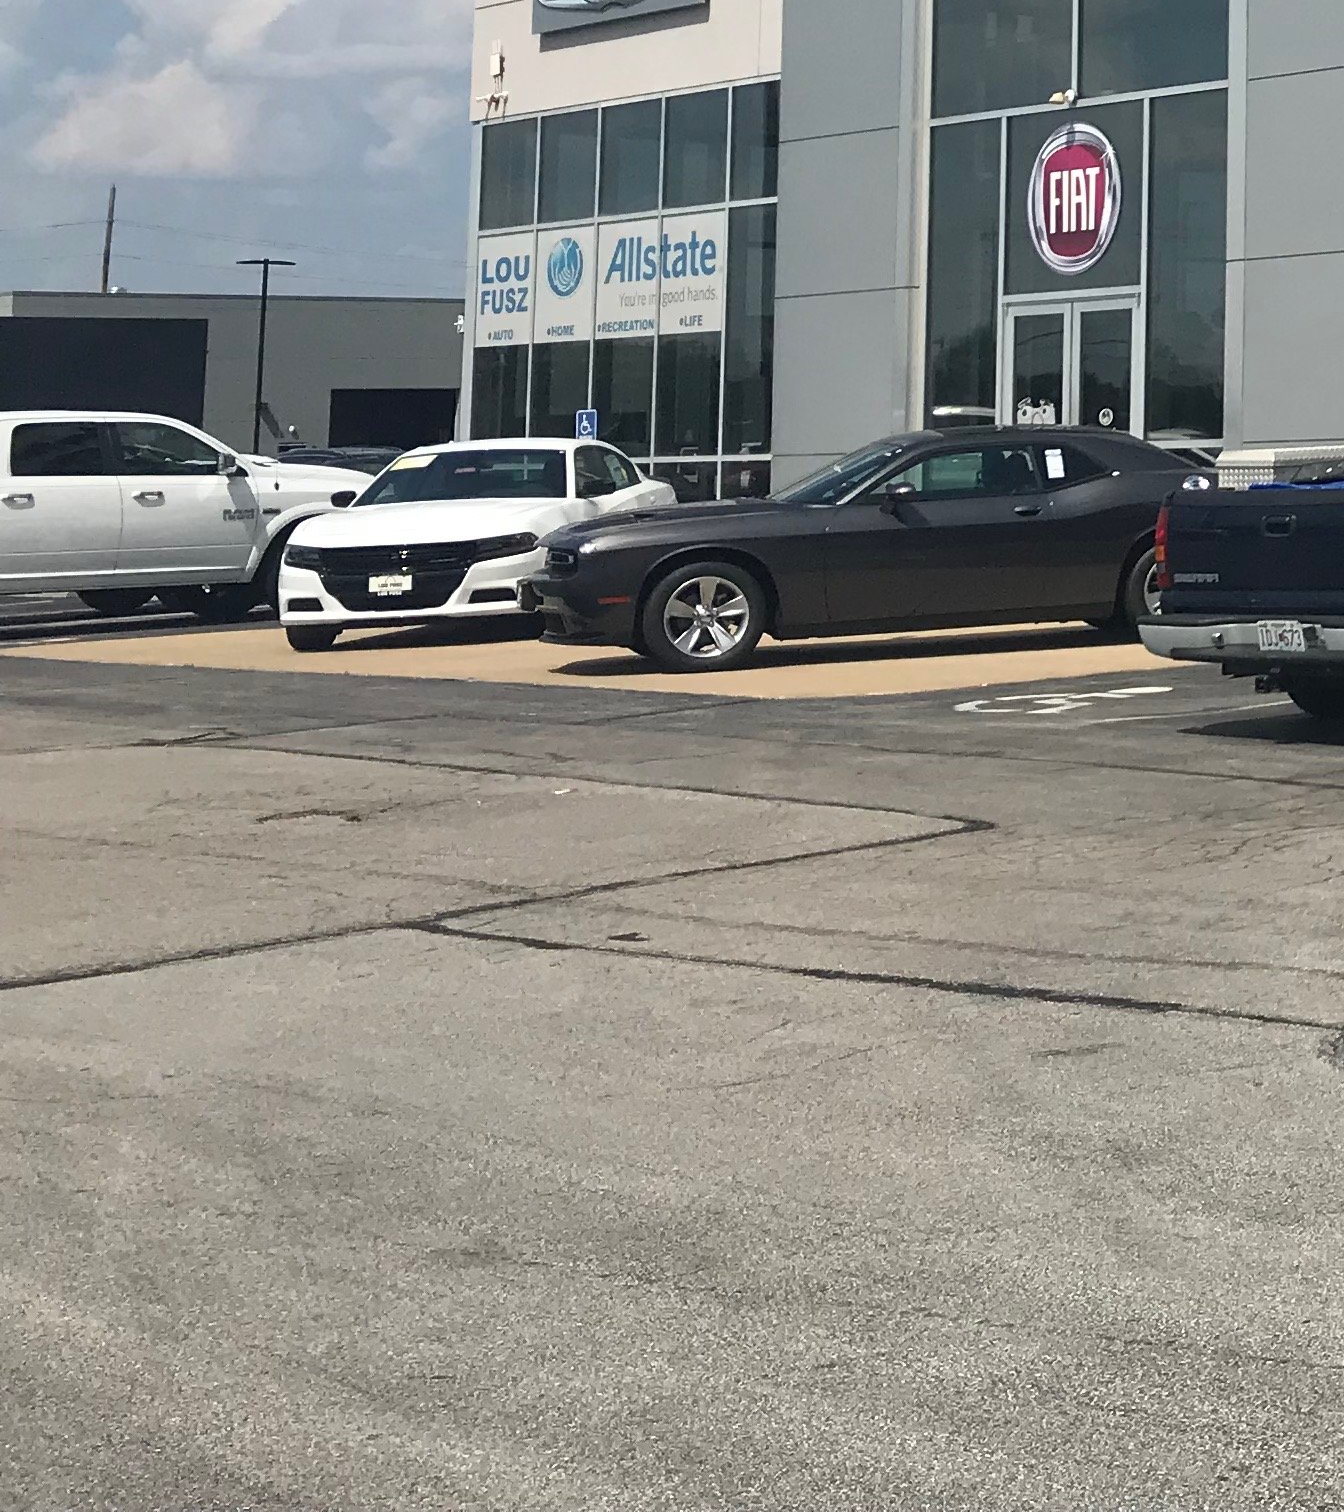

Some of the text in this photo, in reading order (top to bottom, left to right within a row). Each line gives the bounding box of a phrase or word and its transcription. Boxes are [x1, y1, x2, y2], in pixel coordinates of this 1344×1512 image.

[1049, 166, 1100, 234] FIAT
[603, 230, 717, 285] Allstate
[481, 255, 530, 284] LOU
[480, 287, 529, 316] FUSZ
[619, 291, 647, 307] You're
[662, 286, 685, 307] good
[551, 325, 575, 336] HOME
[602, 319, 655, 333] RECREATION
[684, 315, 703, 327] LIFE
[492, 329, 514, 340] AUTO
